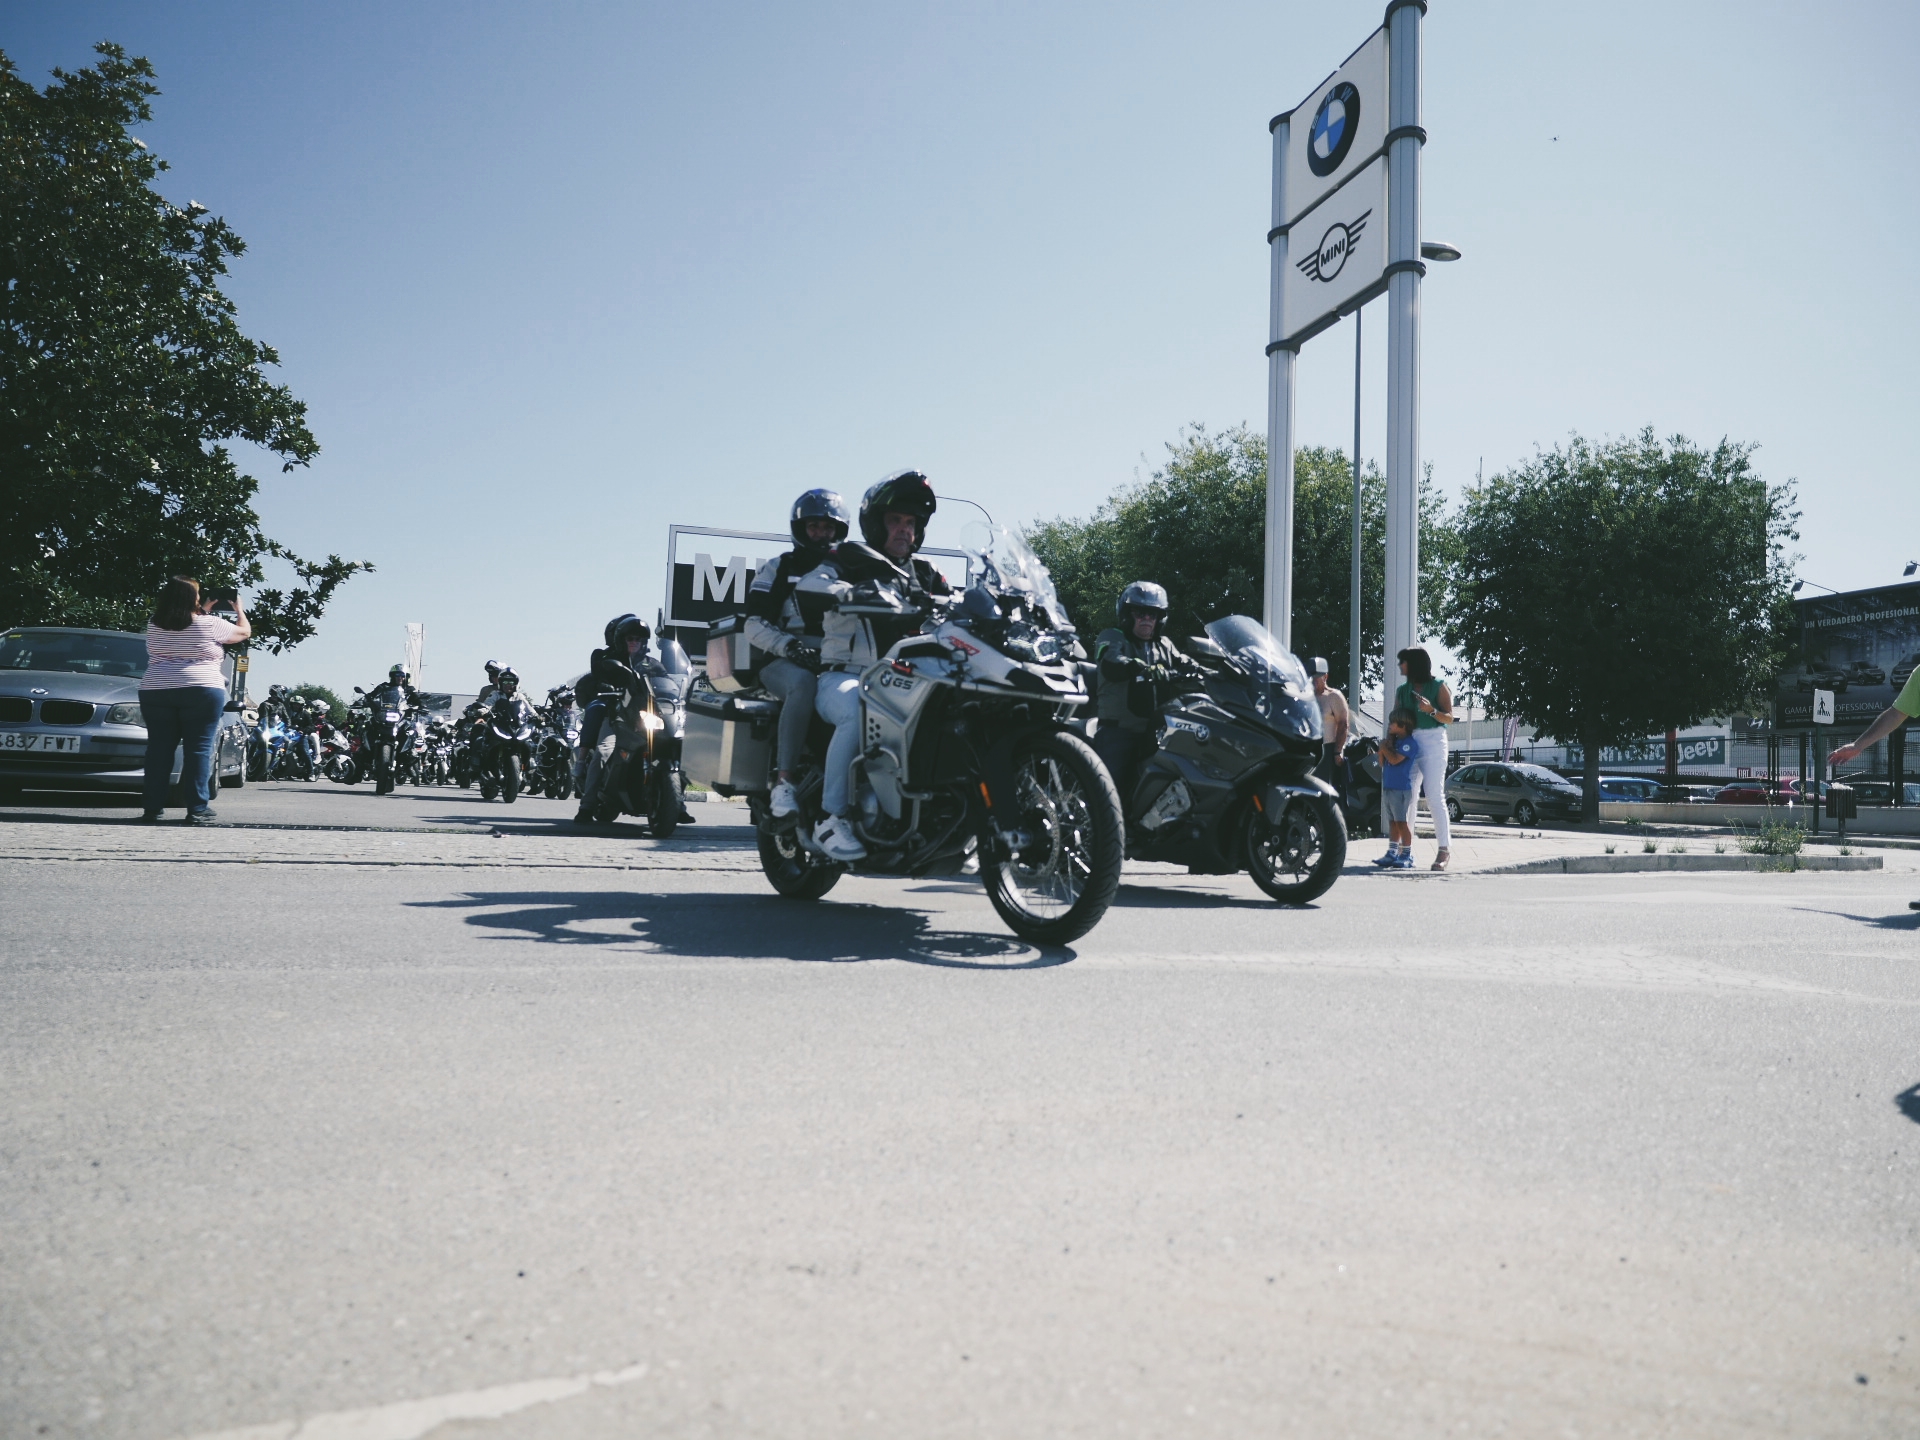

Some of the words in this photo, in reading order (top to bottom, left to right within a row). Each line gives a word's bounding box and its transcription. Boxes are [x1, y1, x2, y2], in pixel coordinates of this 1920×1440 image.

[1321, 238, 1345, 267] MINI
[1805, 620, 1815, 629] UN
[1817, 614, 1862, 628] VERDADERO
[1864, 606, 1920, 622] PROFESIONAL
[893, 677, 914, 690] GS
[1784, 706, 1807, 715] GAMA
[1834, 701, 1885, 713] OFESSIONAL
[1175, 722, 1194, 731] GTL
[43, 736, 77, 751] FWT
[1676, 736, 1720, 764] Jeep
